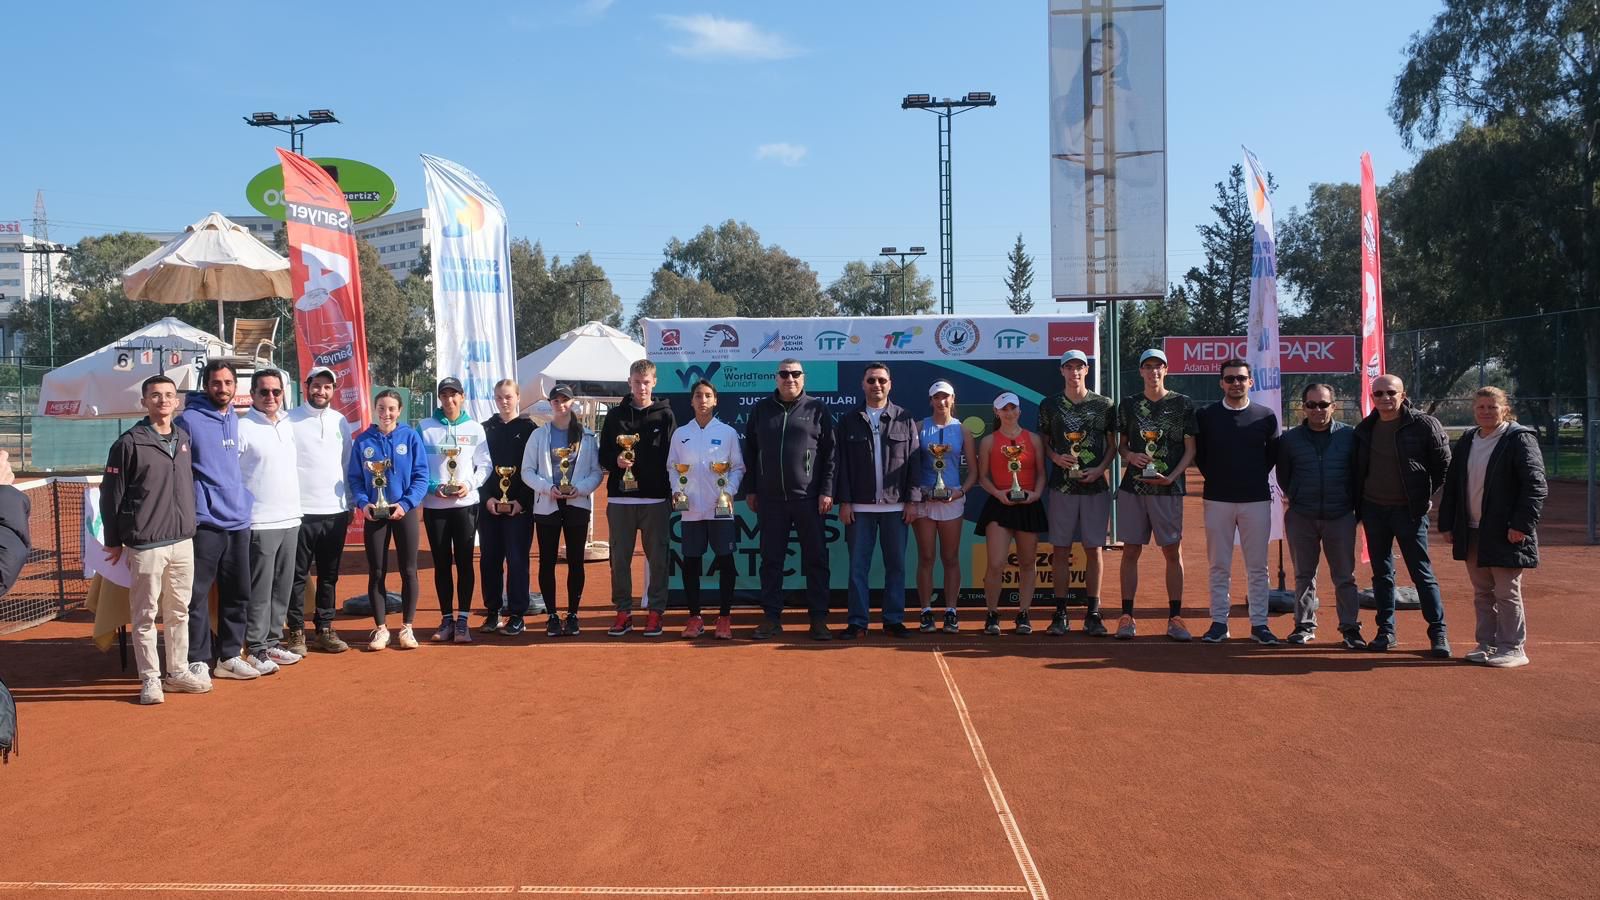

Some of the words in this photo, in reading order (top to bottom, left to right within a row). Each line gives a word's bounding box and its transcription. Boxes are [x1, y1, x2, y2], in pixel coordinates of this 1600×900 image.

[818, 337, 847, 350] ITF
[997, 335, 1027, 348] ITF
[143, 351, 150, 362] 1
[171, 351, 180, 364] 0
[1184, 341, 1335, 362] MEDICPARK
[118, 353, 129, 368] 6
[195, 354, 205, 370] 5
[725, 373, 776, 381] WorldTenn
